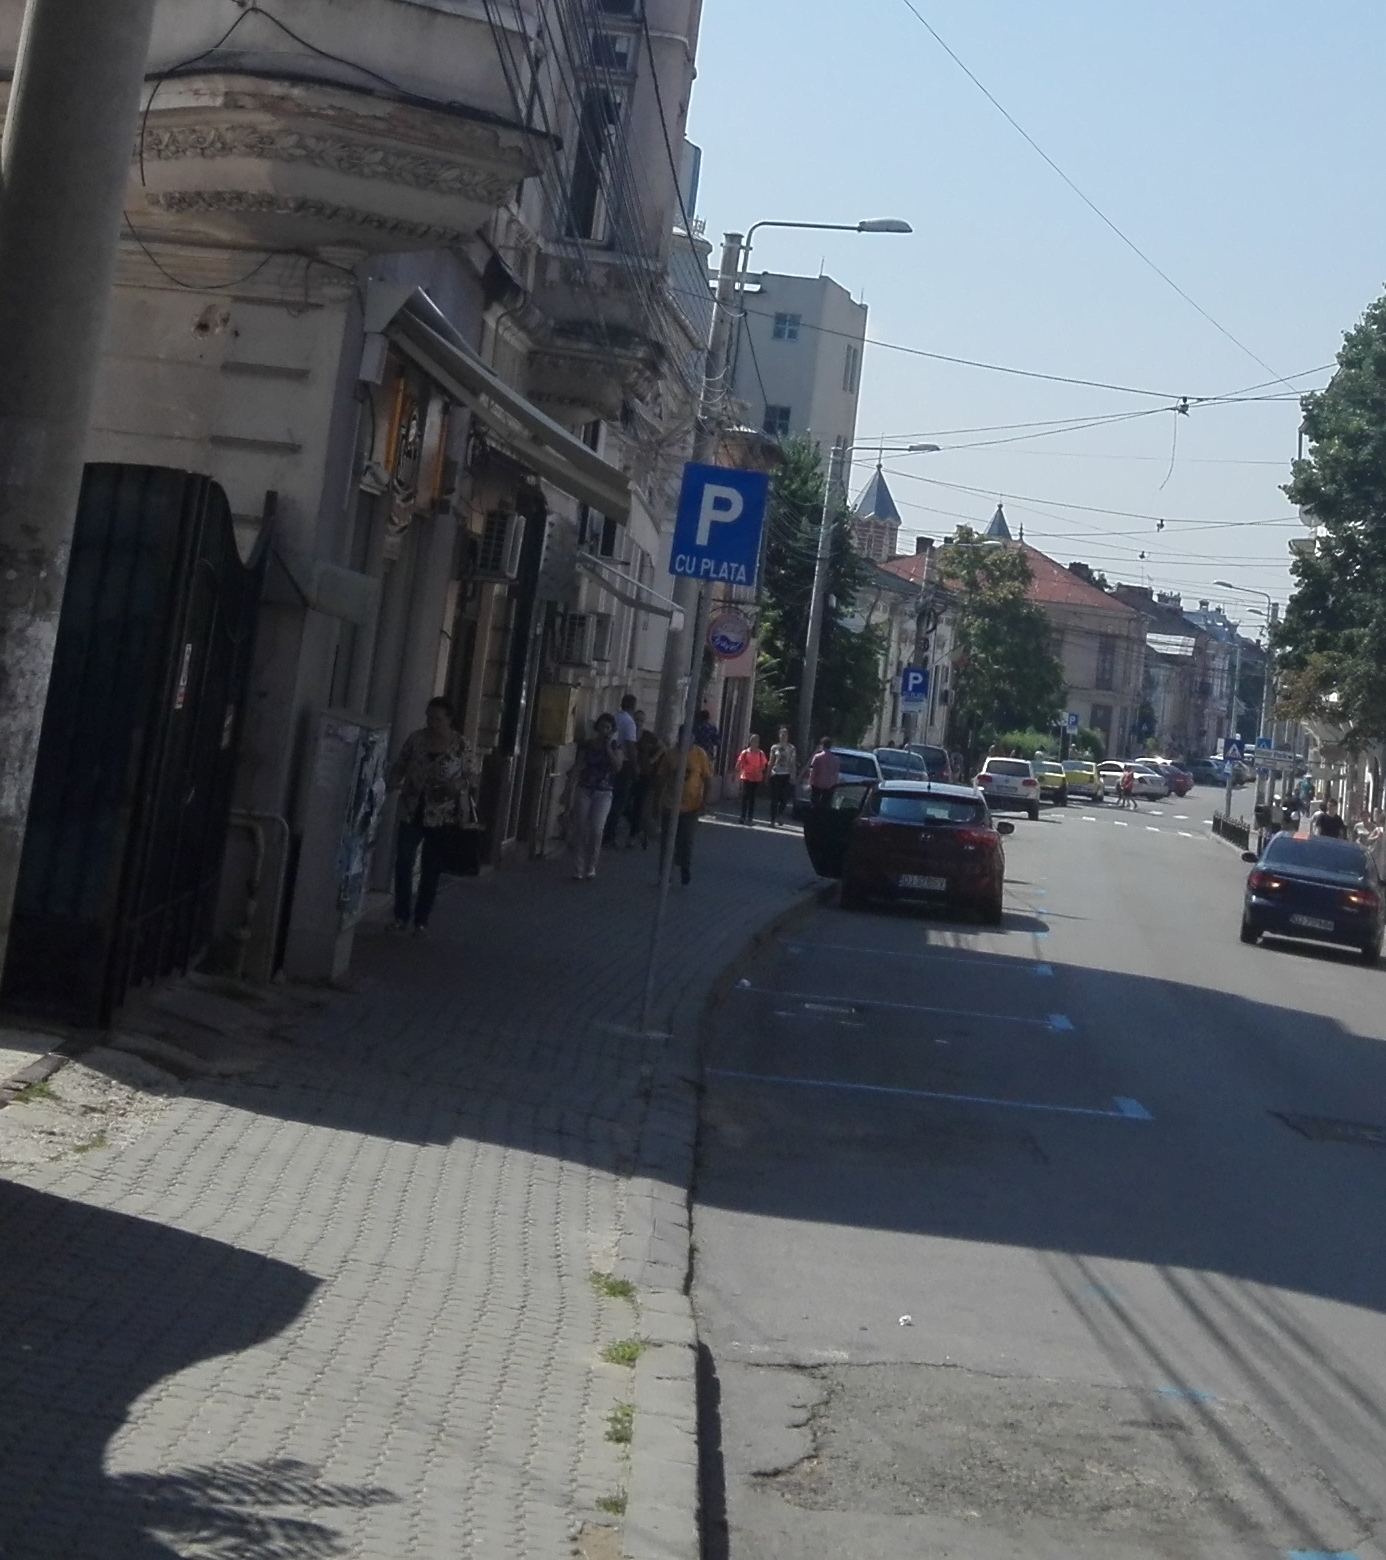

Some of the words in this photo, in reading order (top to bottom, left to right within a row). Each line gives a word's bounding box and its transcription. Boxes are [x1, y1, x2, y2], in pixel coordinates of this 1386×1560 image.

[695, 483, 744, 546] P
[675, 553, 696, 574] CU
[699, 558, 747, 583] PLATA
[908, 672, 923, 692] P
